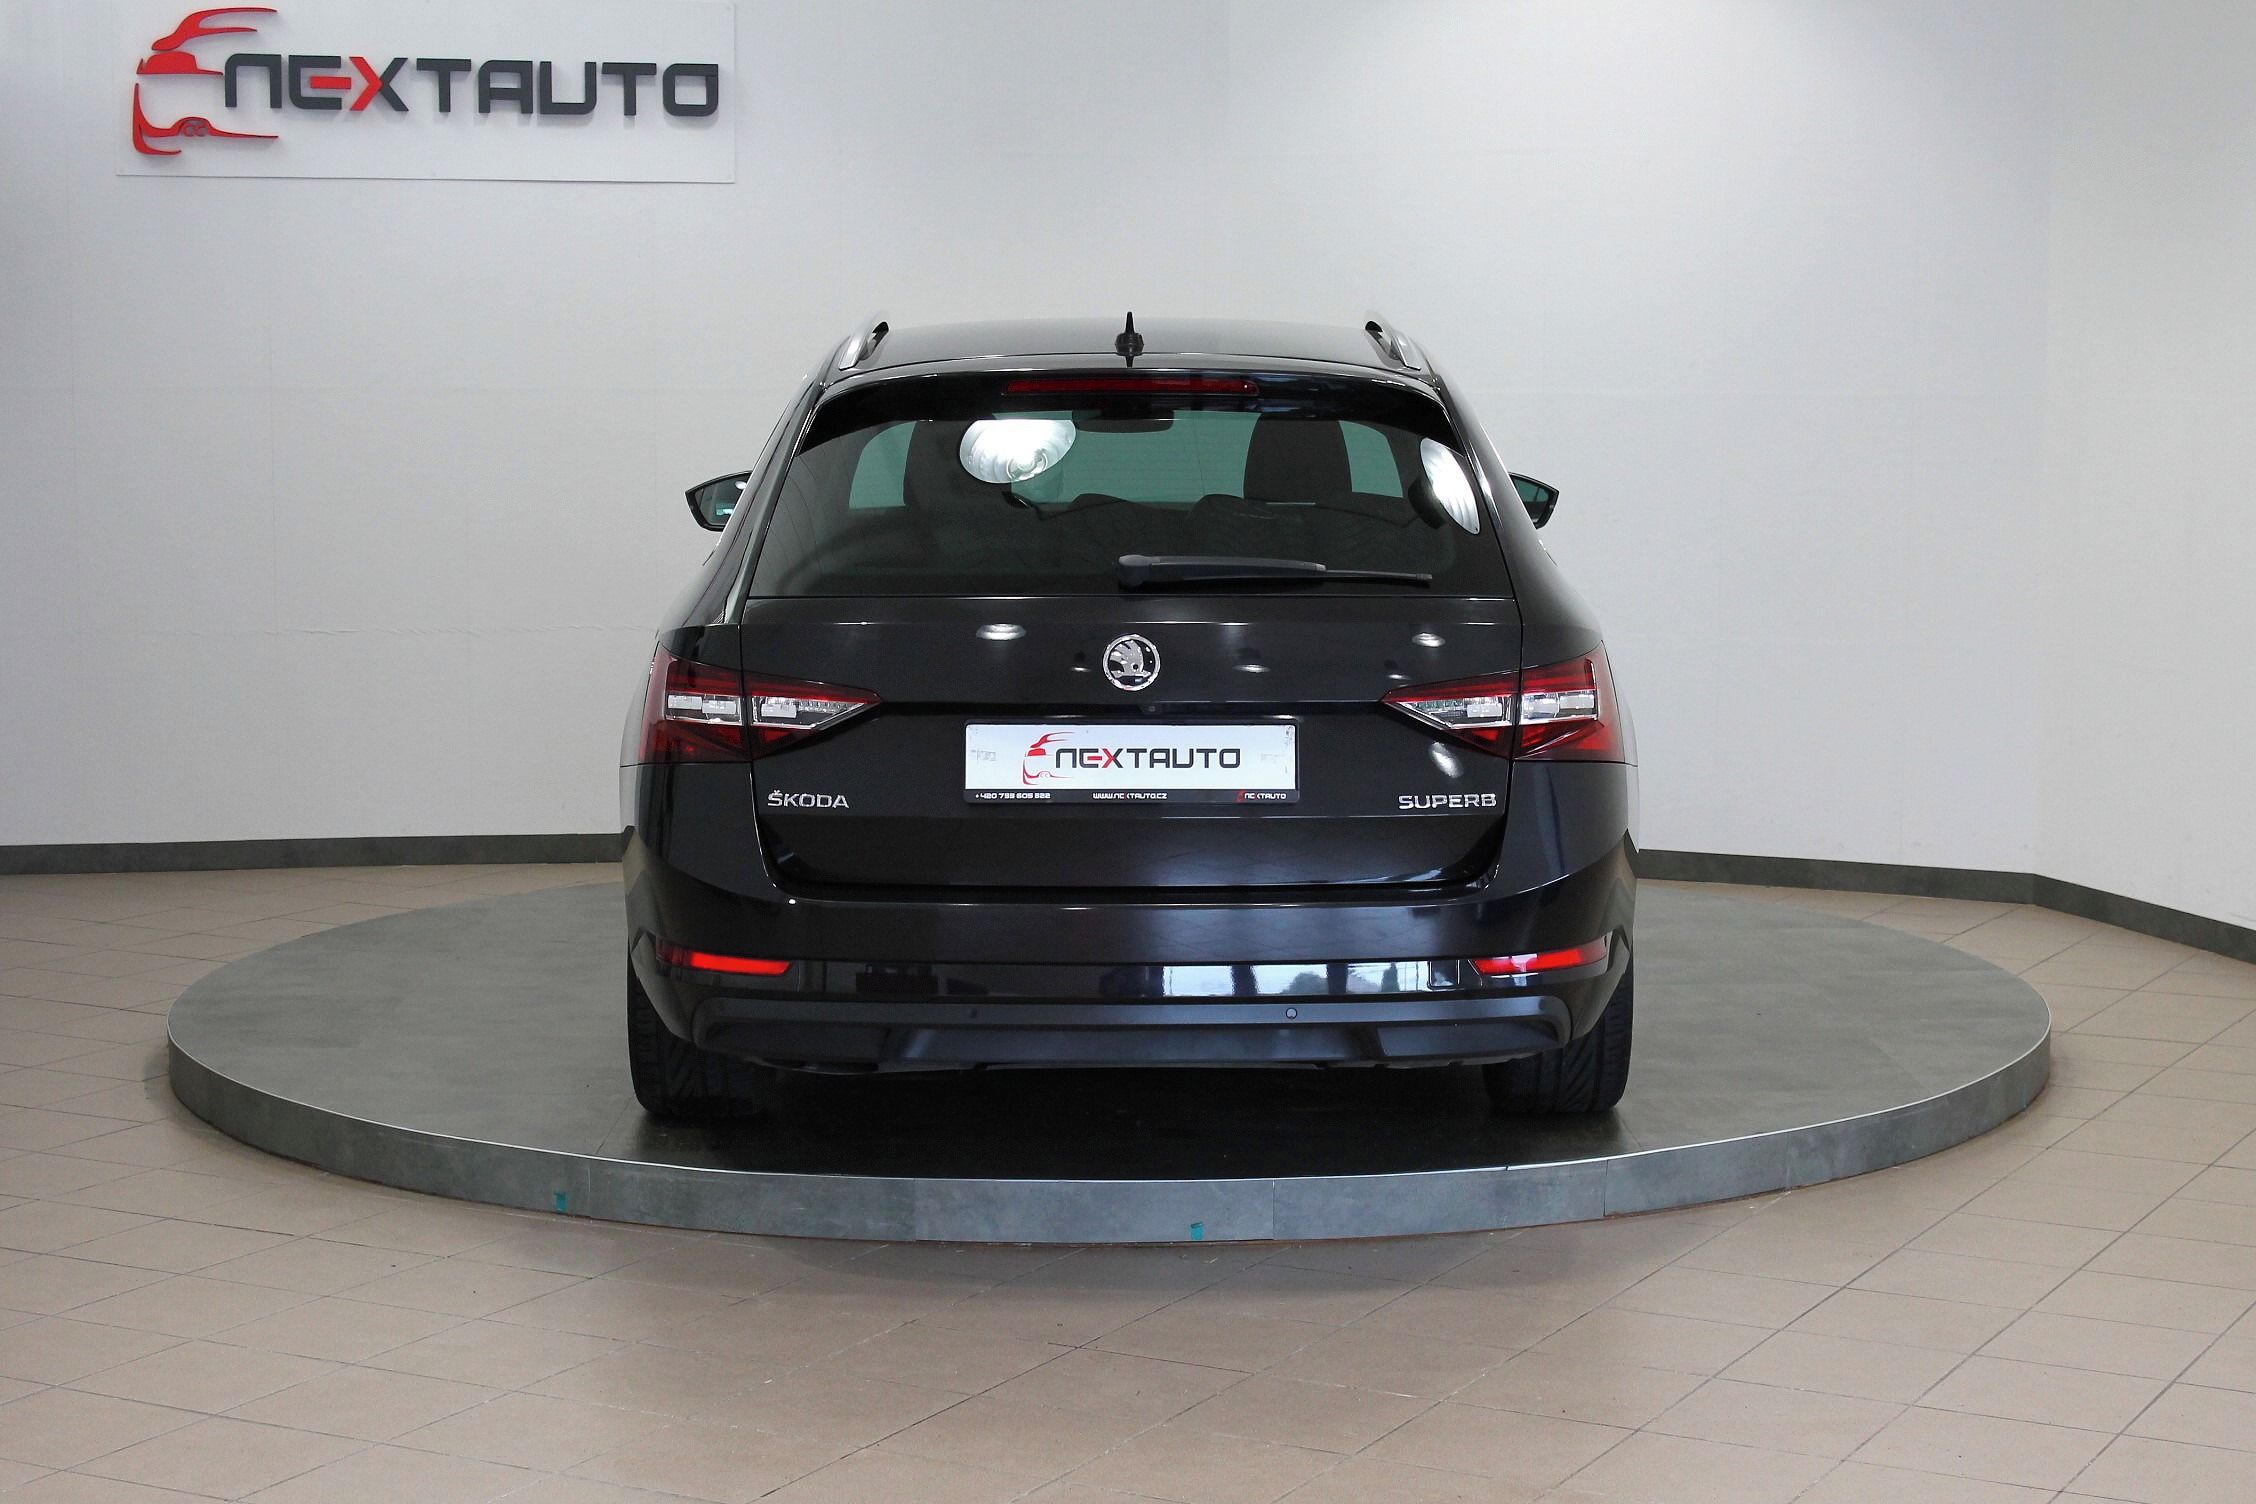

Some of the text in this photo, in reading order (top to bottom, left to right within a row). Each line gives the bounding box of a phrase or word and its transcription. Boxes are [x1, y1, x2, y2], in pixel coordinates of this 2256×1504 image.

[224, 53, 719, 117] NEXTAUTO
[1055, 748, 1241, 769] NEXTAUTO
[767, 789, 850, 809] ŠKODA
[1398, 793, 1497, 810] SUPERB
